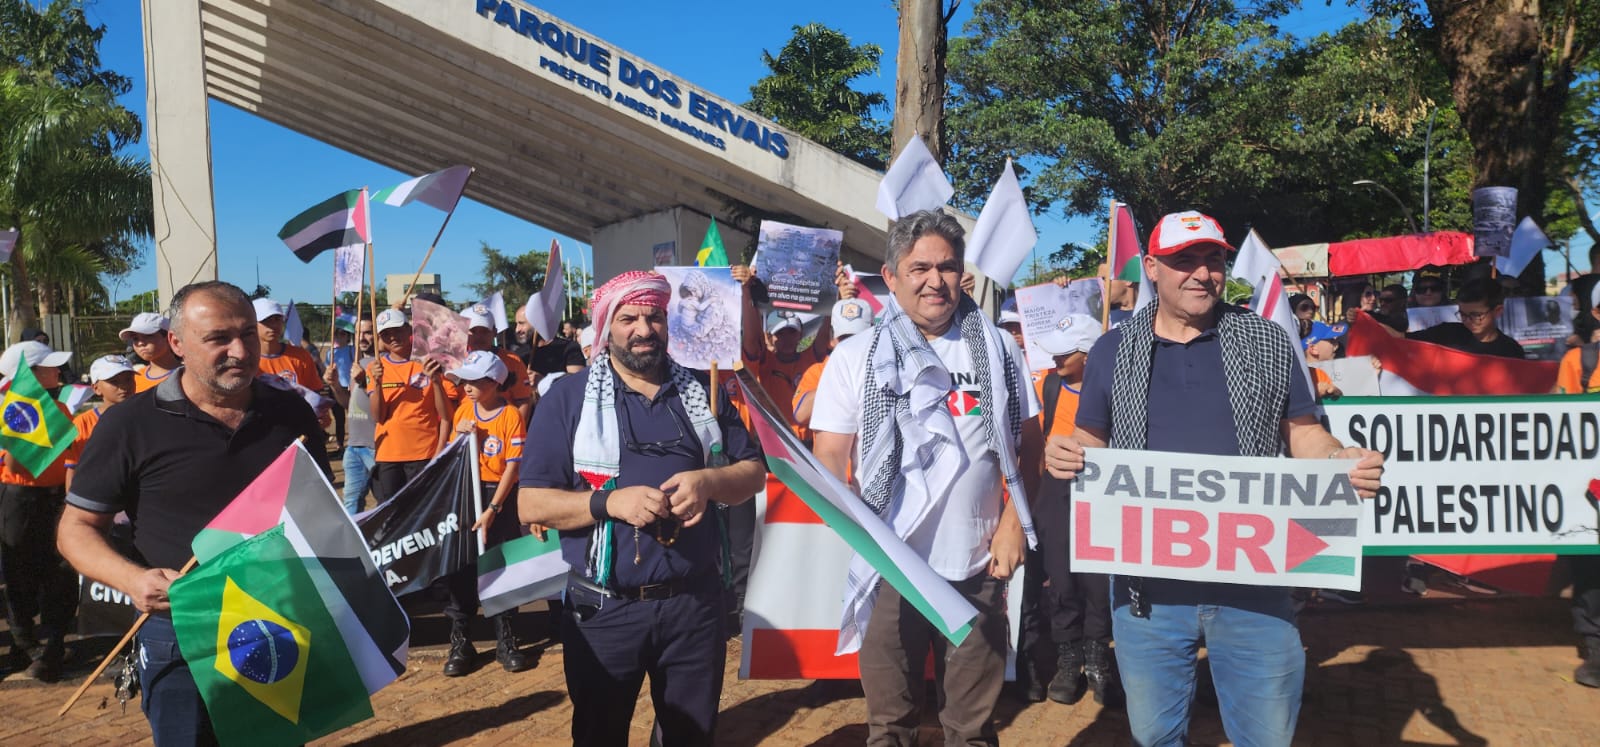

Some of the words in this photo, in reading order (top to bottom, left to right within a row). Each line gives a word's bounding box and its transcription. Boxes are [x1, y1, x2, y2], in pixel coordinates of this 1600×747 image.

[476, 0, 611, 77] PARQUE
[619, 56, 682, 109] DOS
[688, 91, 789, 160] ERVAIS
[539, 56, 613, 99] PREFEITO
[614, 92, 659, 120] AIRES
[660, 111, 727, 151] MARQUES
[1348, 412, 1600, 462] SOLIDARIEDAD
[1074, 460, 1359, 507] PALESTINA
[1374, 484, 1564, 534] PALESTINO
[370, 527, 436, 568] DEVEM
